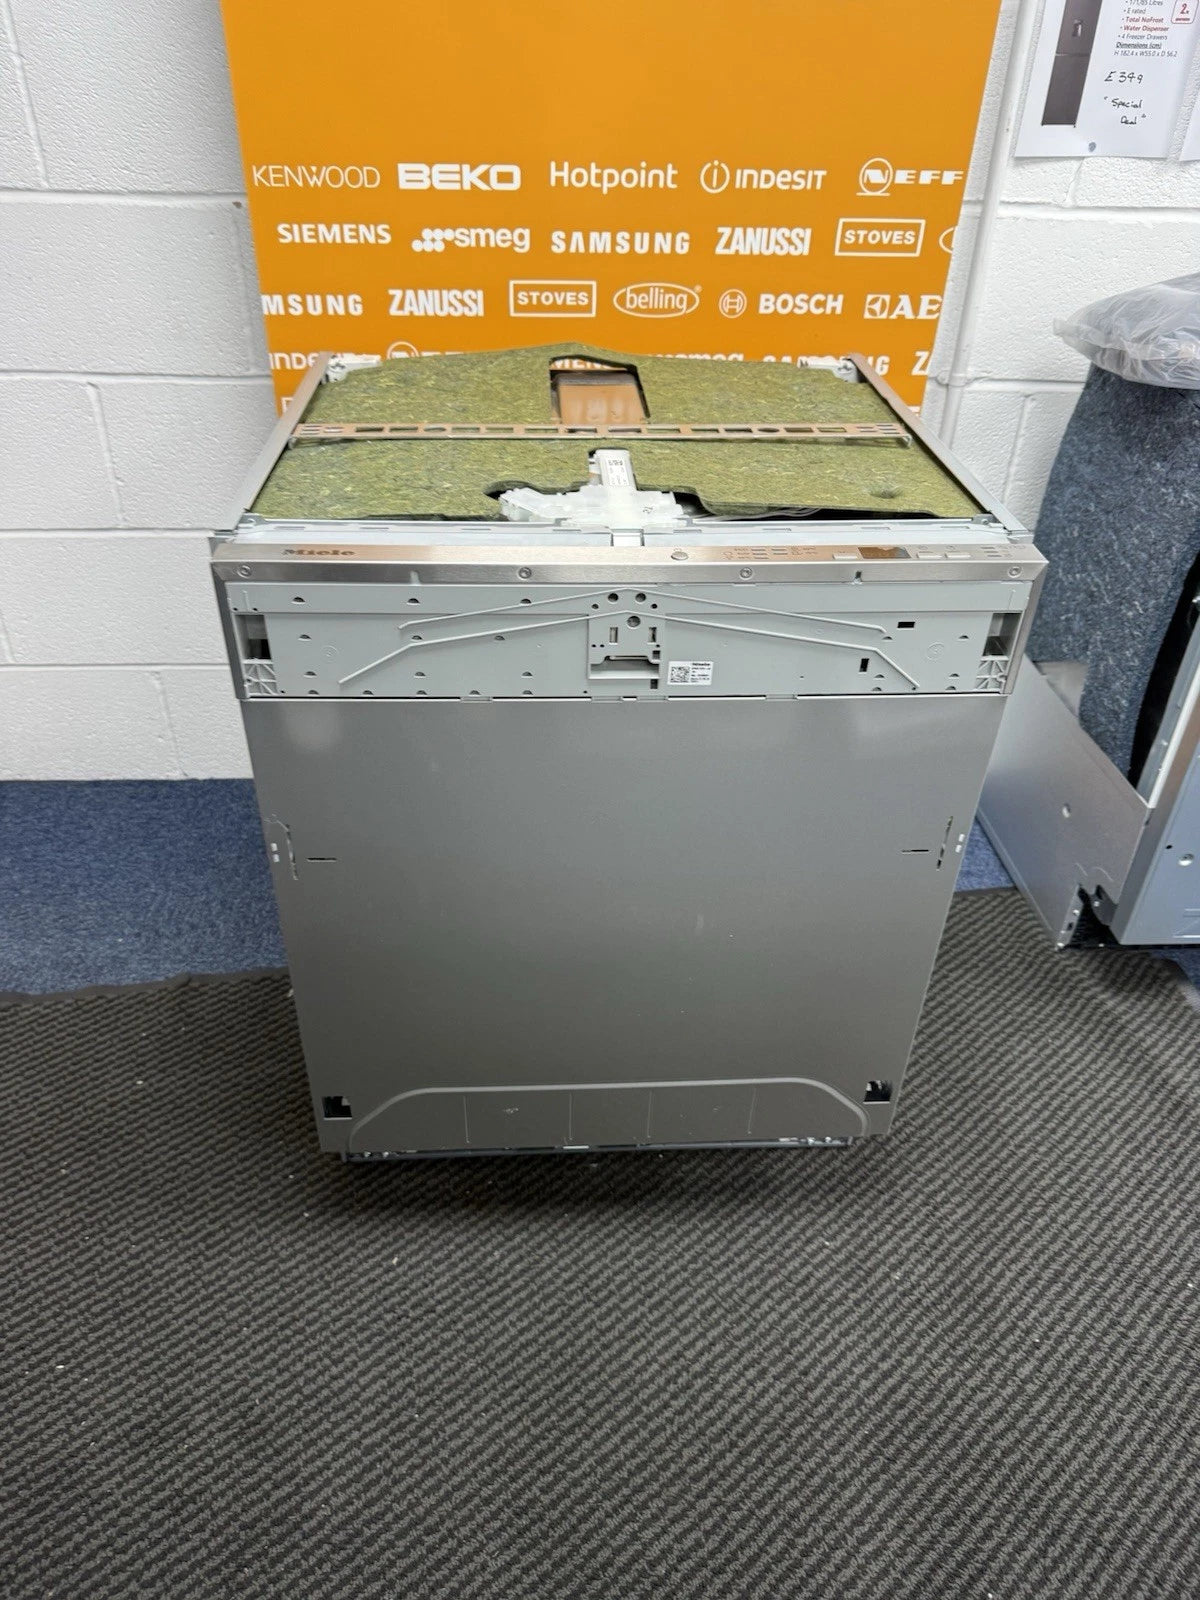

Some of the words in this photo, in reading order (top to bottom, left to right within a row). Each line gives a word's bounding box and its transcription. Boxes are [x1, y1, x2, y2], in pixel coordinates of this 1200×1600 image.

[252, 165, 380, 189] KENWOOD
[397, 162, 522, 191] BEKO
[549, 160, 678, 195] Hotpoint
[861, 168, 964, 188] NEFF
[276, 223, 392, 245] SIEMENS
[453, 227, 531, 254] smeg
[550, 230, 690, 255] SAMSUNG
[715, 226, 812, 256] ZANUSSI
[844, 229, 917, 246] STOVES
[388, 288, 485, 317] ZANUSSI
[517, 291, 589, 306] STOVES
[625, 286, 688, 314] belling
[758, 293, 844, 315] BOSCH
